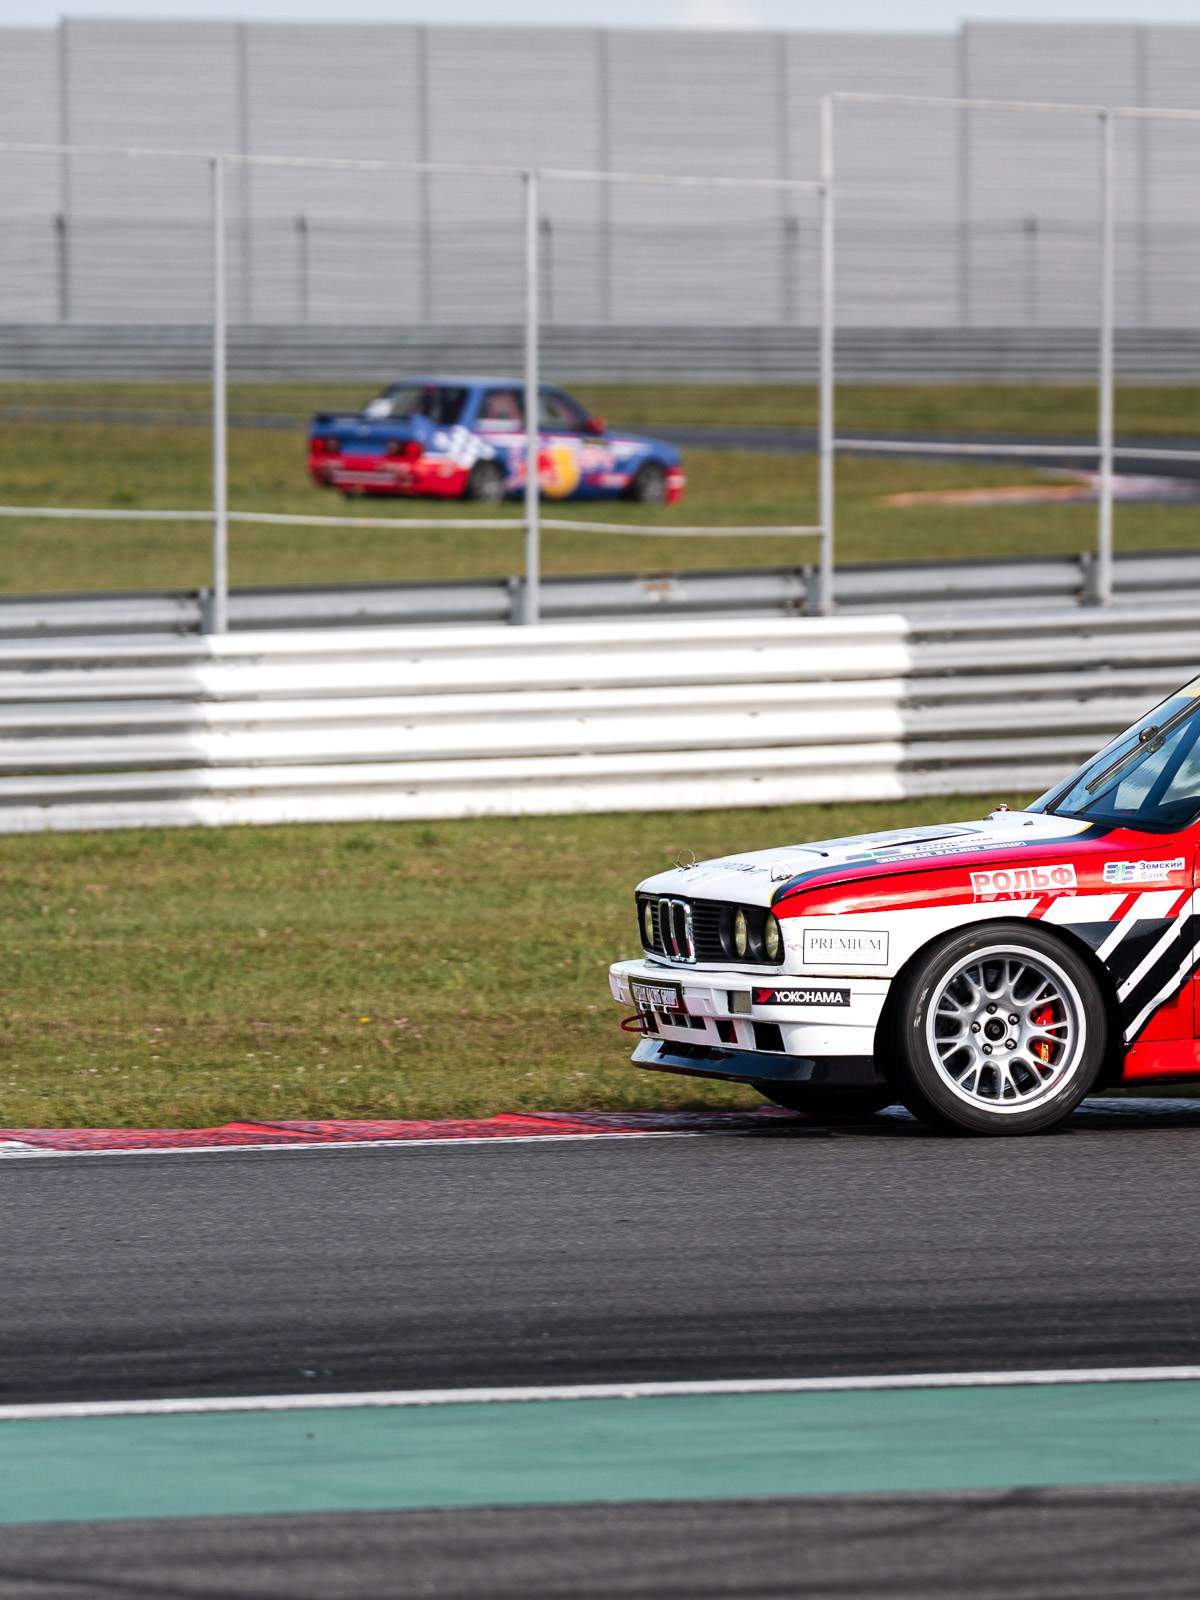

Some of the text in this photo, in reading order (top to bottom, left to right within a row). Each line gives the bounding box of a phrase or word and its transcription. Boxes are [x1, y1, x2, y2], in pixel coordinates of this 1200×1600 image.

[1139, 859, 1183, 870] Земский
[973, 867, 1074, 892] РОЛЬФ
[1140, 871, 1164, 880] банк
[810, 938, 881, 950] PREMIUM
[774, 991, 844, 1004] YOKOHAMA
